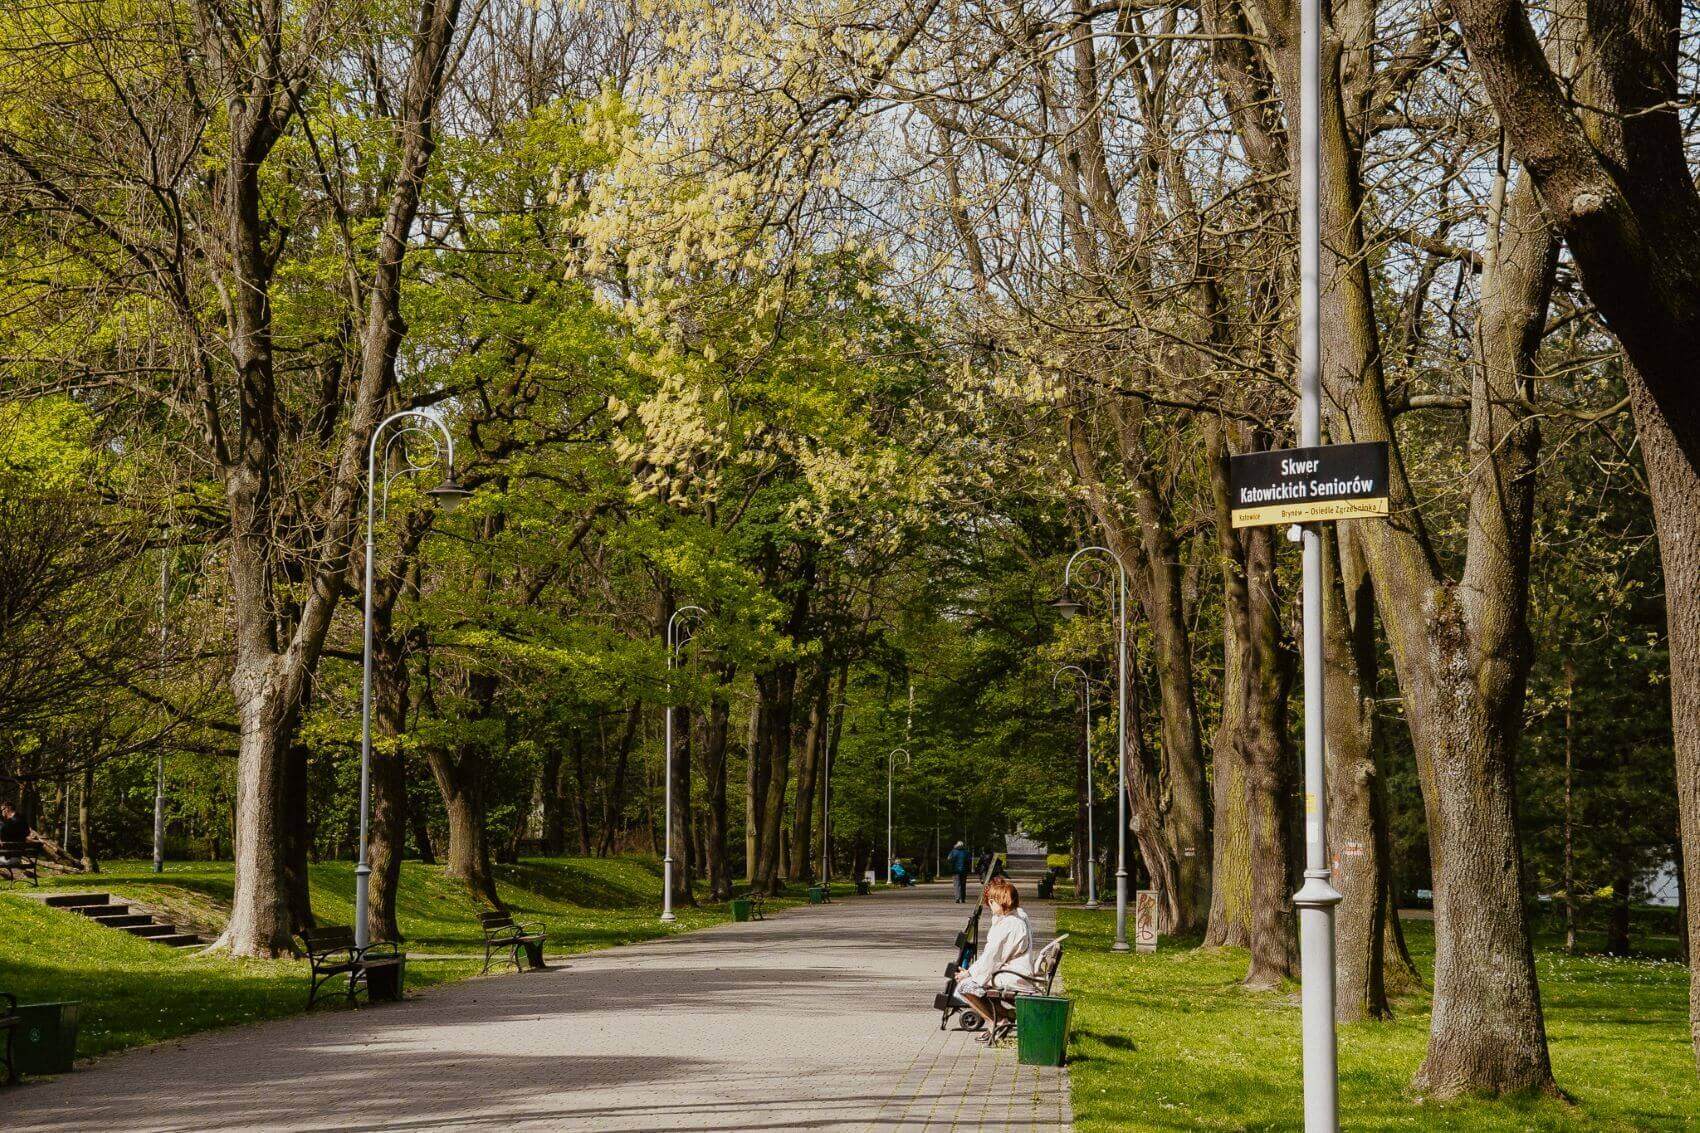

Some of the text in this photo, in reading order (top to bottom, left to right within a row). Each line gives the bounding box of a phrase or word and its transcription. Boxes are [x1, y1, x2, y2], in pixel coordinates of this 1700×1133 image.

[1281, 458, 1319, 476] Skwer
[1240, 475, 1373, 503] Katowickich Seniorów
[1310, 507, 1333, 515] Osiedle
